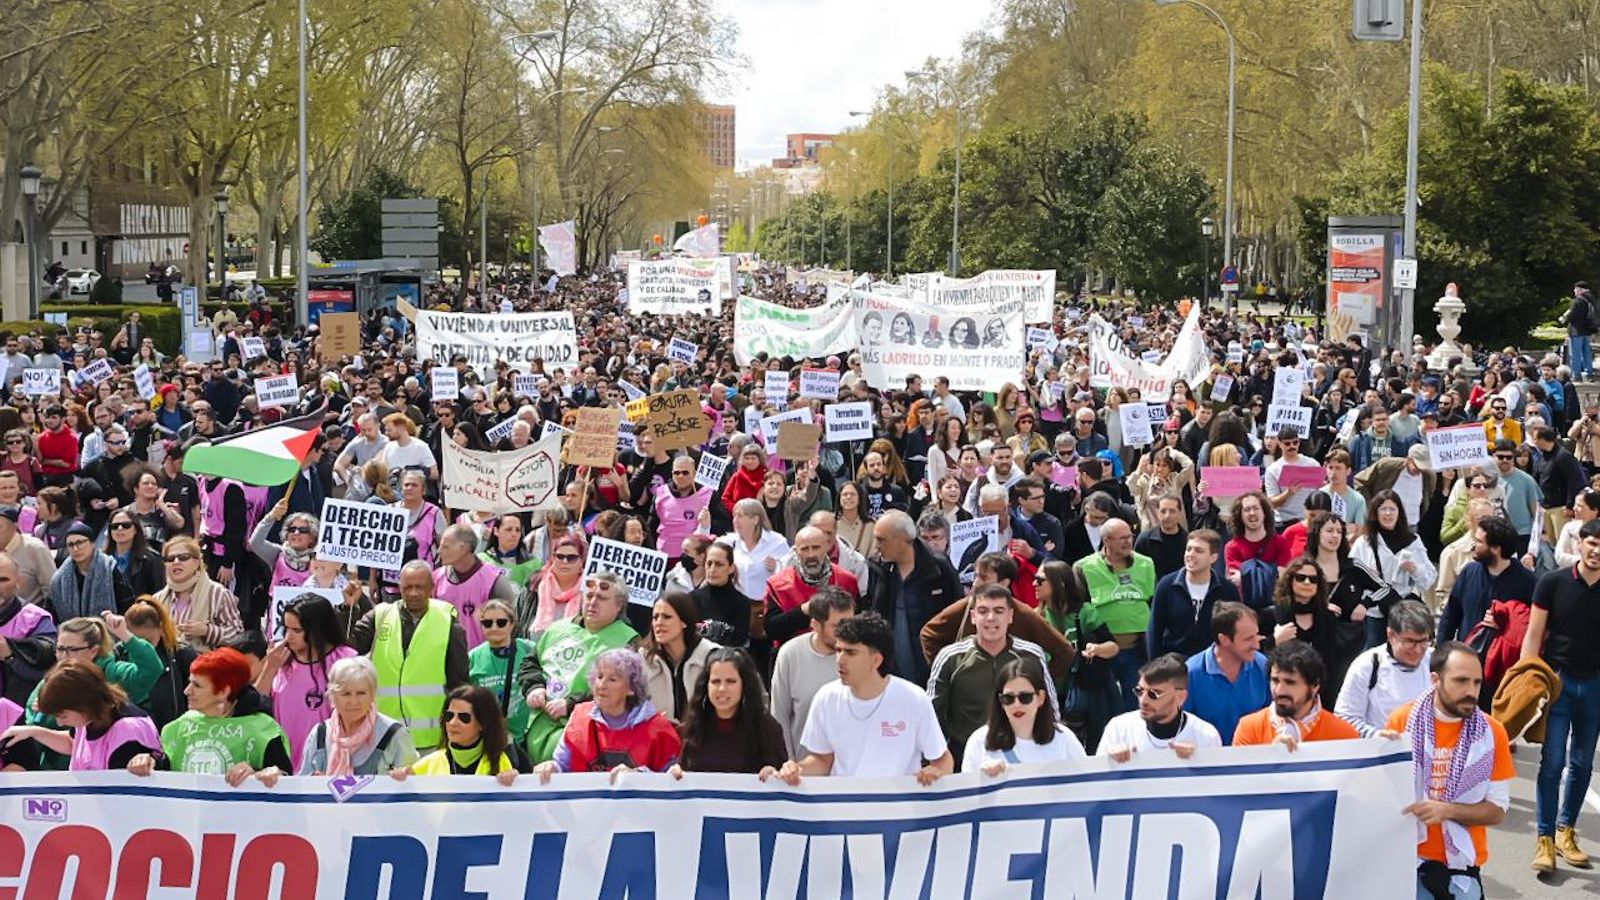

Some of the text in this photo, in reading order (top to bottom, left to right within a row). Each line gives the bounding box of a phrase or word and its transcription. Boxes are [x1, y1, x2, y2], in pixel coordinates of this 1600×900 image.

[428, 316, 573, 334] VIVIENDA UNIVERSAL
[432, 344, 491, 363] GRATUITA
[506, 345, 523, 363] DE
[525, 344, 571, 363] CALIDAD
[882, 353, 931, 366] LADRILLO
[933, 355, 948, 367] EN
[950, 356, 981, 368] MONTE
[991, 356, 1022, 370] PRADO
[653, 417, 702, 438] RESISTE
[1439, 450, 1453, 462] SIN
[519, 456, 547, 478] STOP
[464, 483, 497, 501] CALLE
[325, 504, 405, 532] DERECHO
[321, 525, 402, 553] A TECHO
[320, 545, 400, 565] A JUSTO PRECIO!
[591, 542, 665, 574] DERECHO
[586, 561, 598, 576] A
[208, 723, 244, 738] CASA
[344, 833, 504, 900] DE
[724, 808, 1297, 900] VIVIENDA
